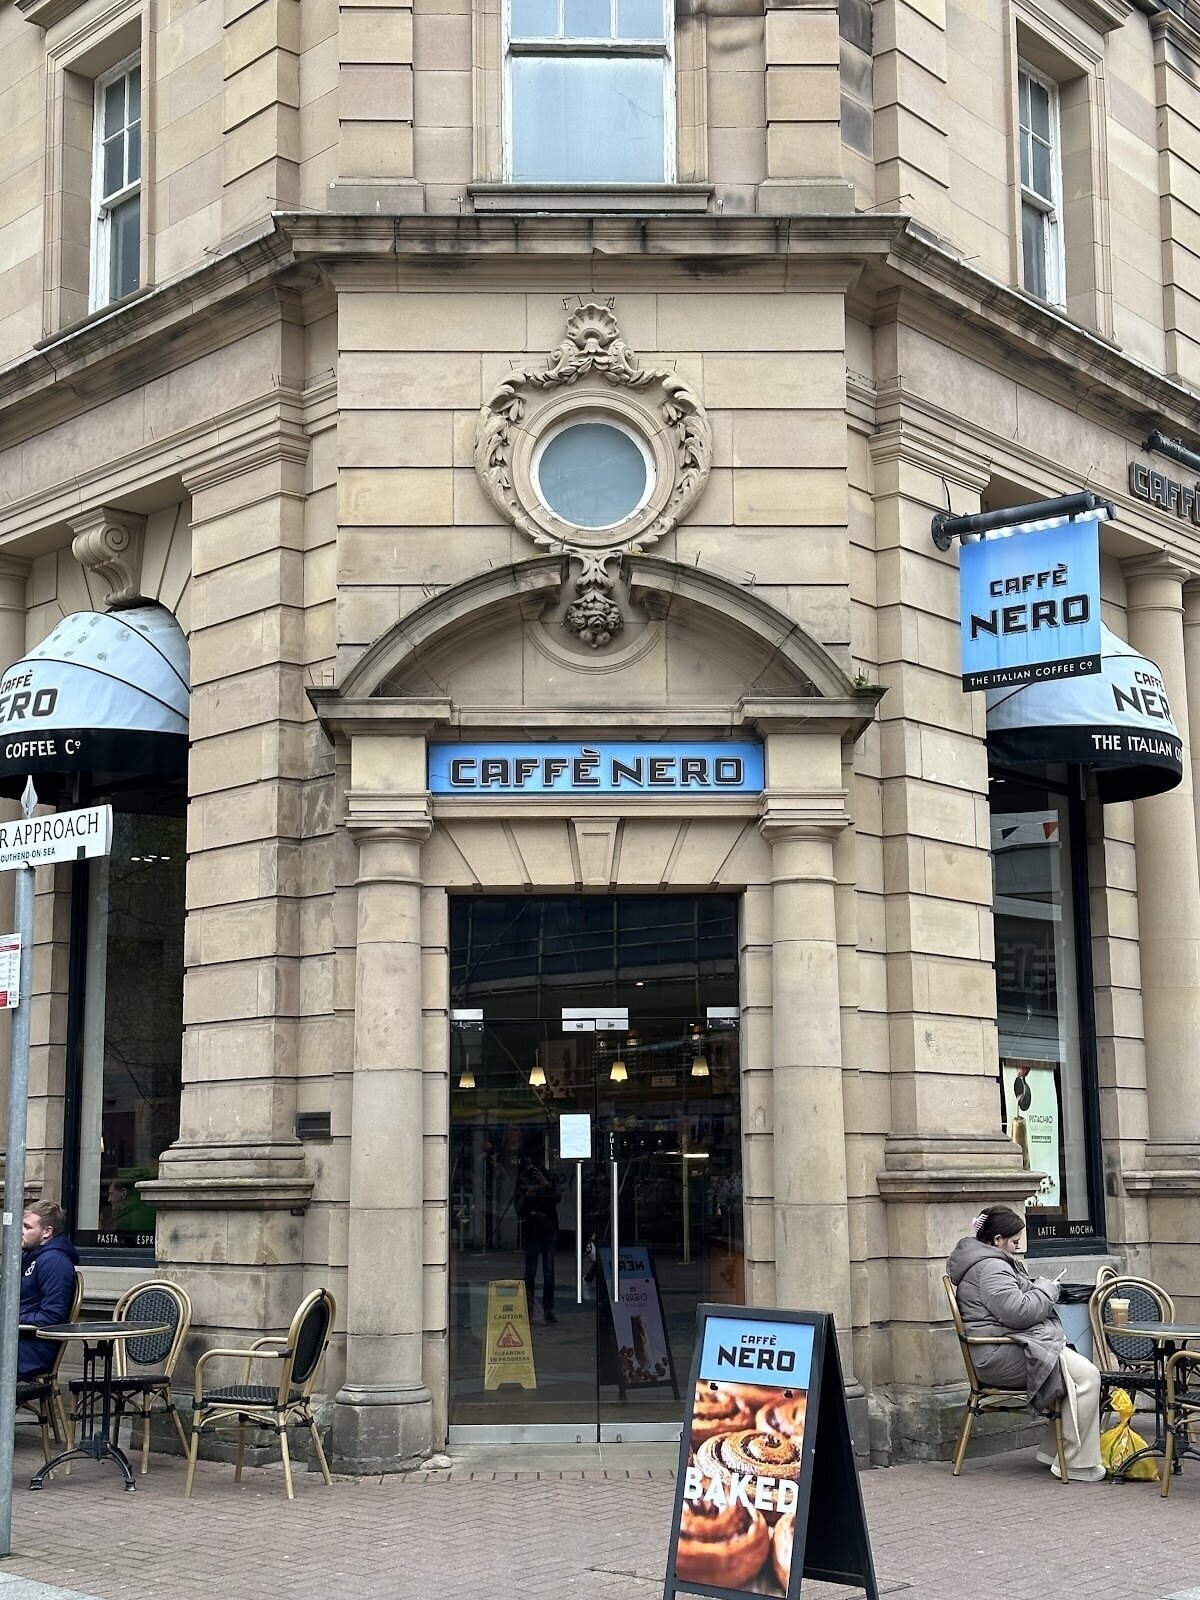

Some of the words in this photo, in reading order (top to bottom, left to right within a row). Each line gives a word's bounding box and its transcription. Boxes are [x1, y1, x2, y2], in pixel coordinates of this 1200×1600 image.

[989, 563, 1069, 598] CAFFÈ
[969, 593, 1091, 641] NERO
[970, 676, 989, 686] THE
[992, 669, 1031, 683] ITALIAN
[1035, 663, 1075, 677] COFFEE
[5, 740, 57, 760] COFFEE
[1091, 734, 1122, 752] THE
[1127, 735, 1173, 758] ITALIAN
[448, 746, 601, 787] CAFFÈ
[611, 756, 745, 788] NERO
[13, 812, 99, 847] APPROACH
[96, 1233, 119, 1244] PASTA
[1037, 1225, 1056, 1236] LATTE
[1069, 1224, 1094, 1236] MOCHA
[740, 1334, 777, 1346] CAFFÈ
[717, 1344, 796, 1372] NERO
[683, 1466, 800, 1514] BAKED
